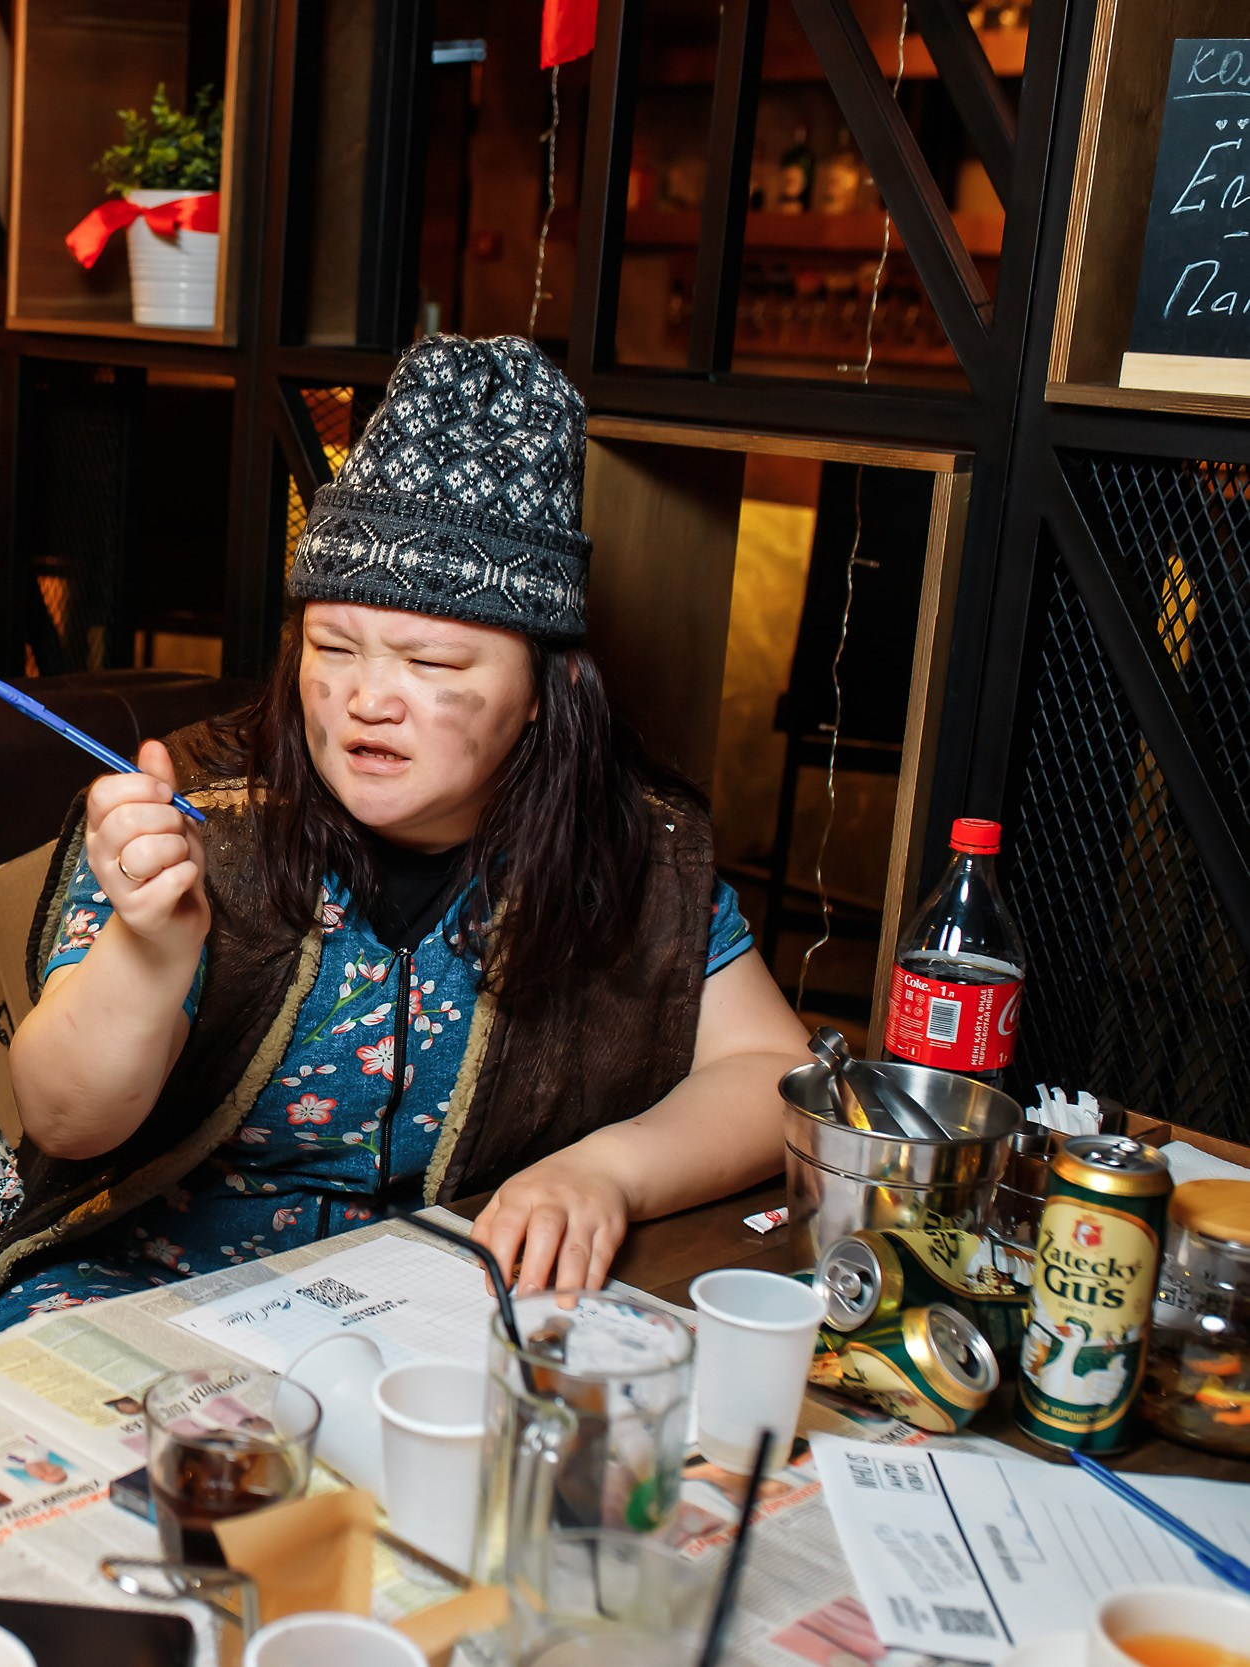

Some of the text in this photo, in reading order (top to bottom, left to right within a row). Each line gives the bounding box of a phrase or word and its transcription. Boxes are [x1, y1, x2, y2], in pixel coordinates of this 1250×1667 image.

[1187, 46, 1250, 85] КО
[1164, 259, 1250, 319] Па
[904, 974, 929, 992] Coke
[978, 1011, 992, 1065] ПЕРЕРАБОТАЙ
[1044, 1263, 1125, 1309] Gus
